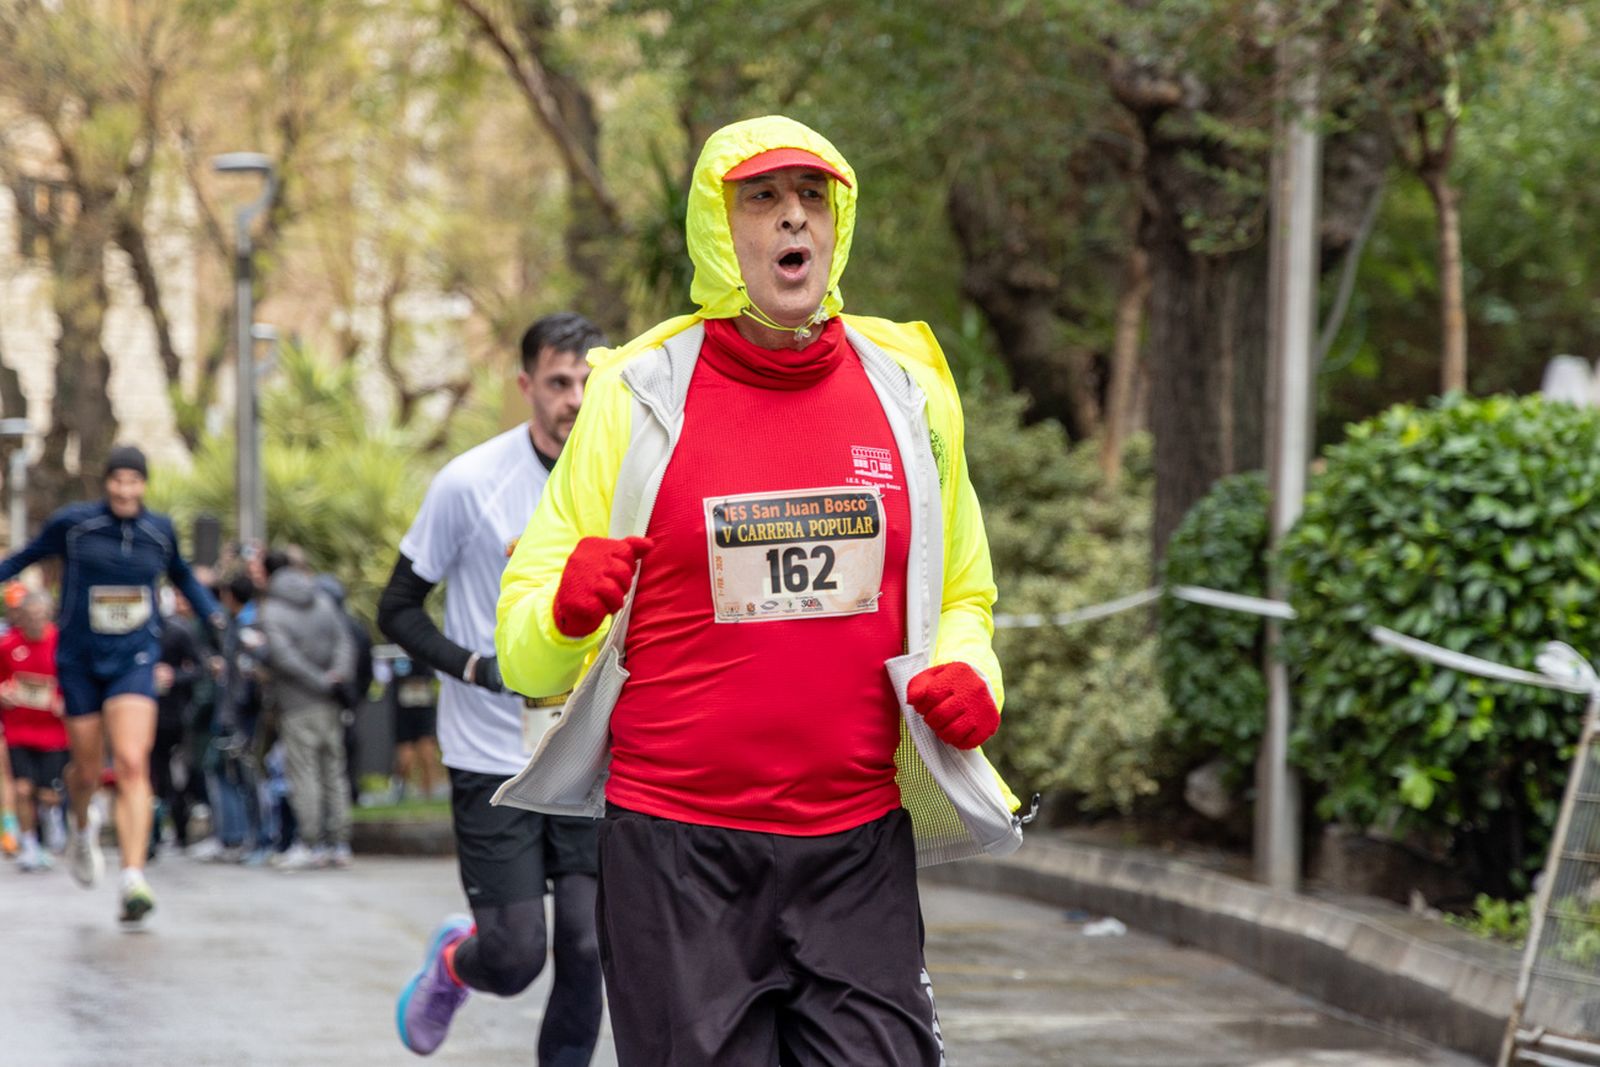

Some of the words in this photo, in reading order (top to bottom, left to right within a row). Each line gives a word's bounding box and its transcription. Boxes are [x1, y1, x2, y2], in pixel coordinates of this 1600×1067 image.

[723, 505, 747, 522] IES
[752, 505, 781, 519] San
[784, 501, 820, 518] Juan
[824, 498, 867, 514] Bosco
[722, 526, 733, 544] V
[737, 521, 805, 542] CARRERA
[808, 516, 874, 537] POPULAR
[766, 545, 838, 594] 162
